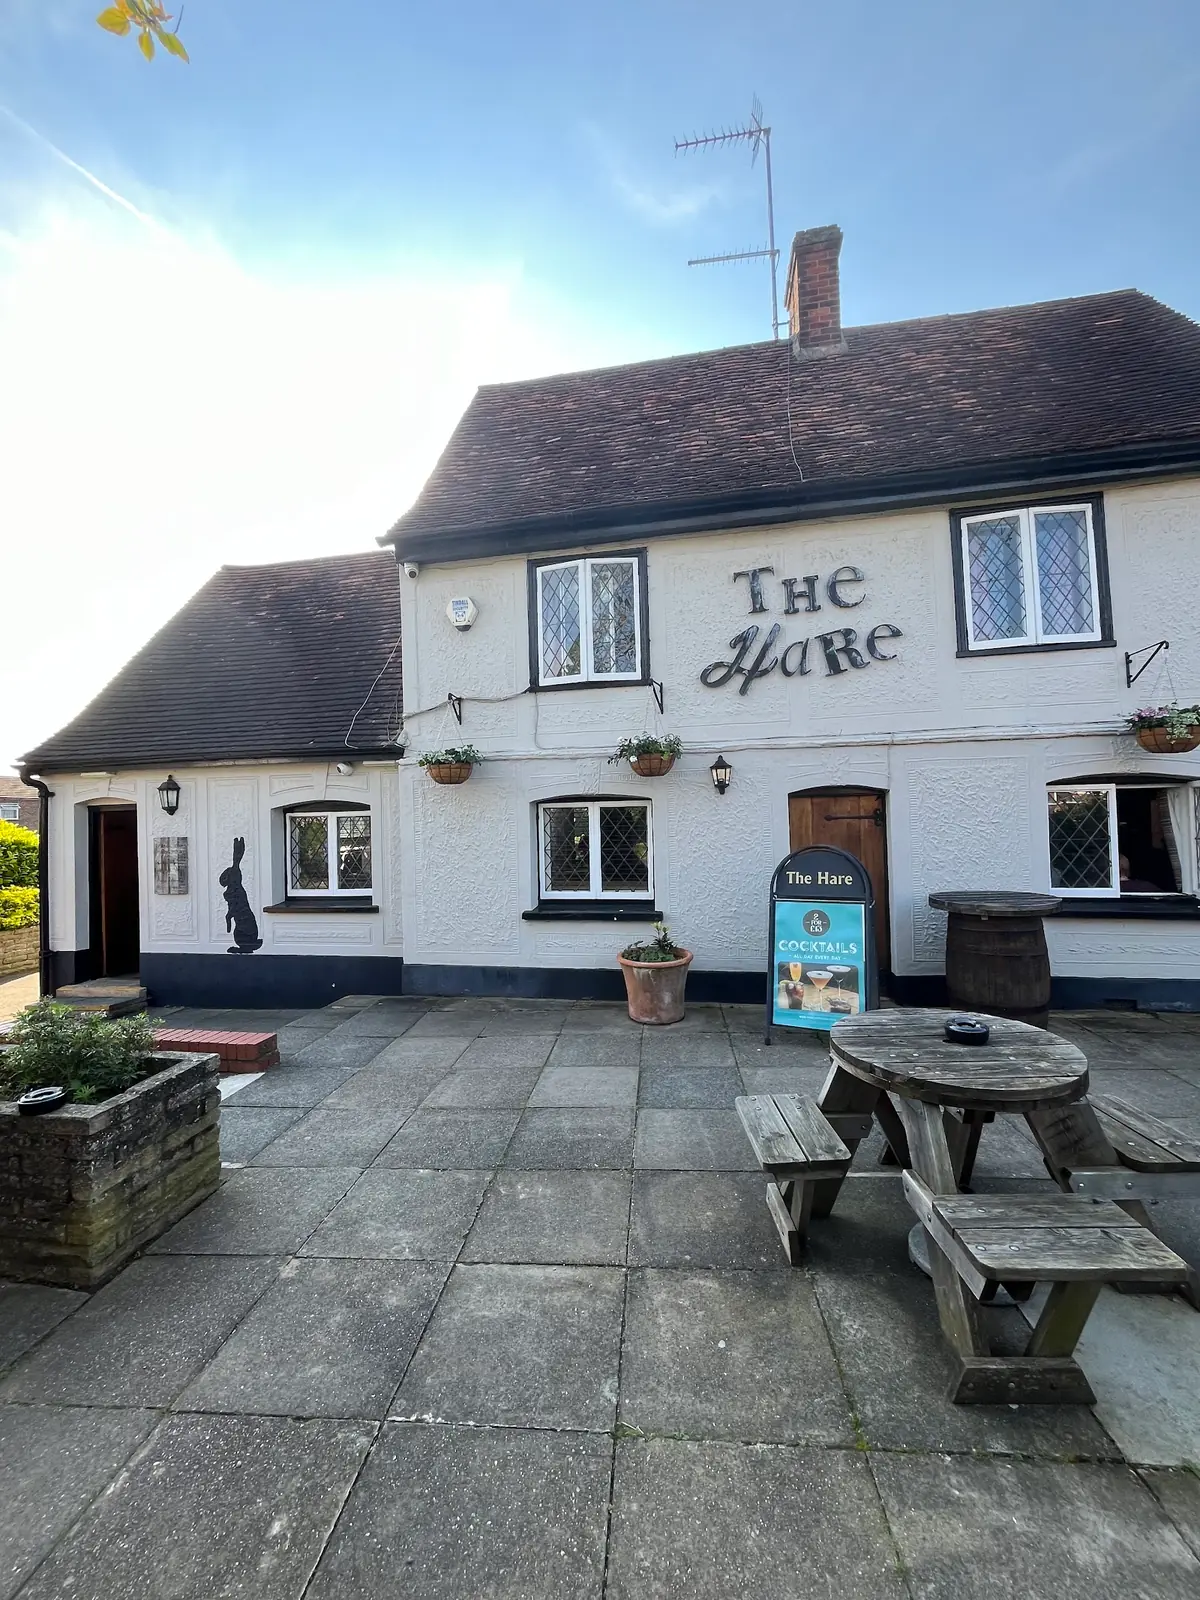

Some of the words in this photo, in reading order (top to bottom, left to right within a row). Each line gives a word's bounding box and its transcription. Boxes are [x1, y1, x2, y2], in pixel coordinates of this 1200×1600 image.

[786, 871, 812, 884] The
[817, 872, 853, 885] Hare
[778, 940, 857, 954] COCKTAILS
